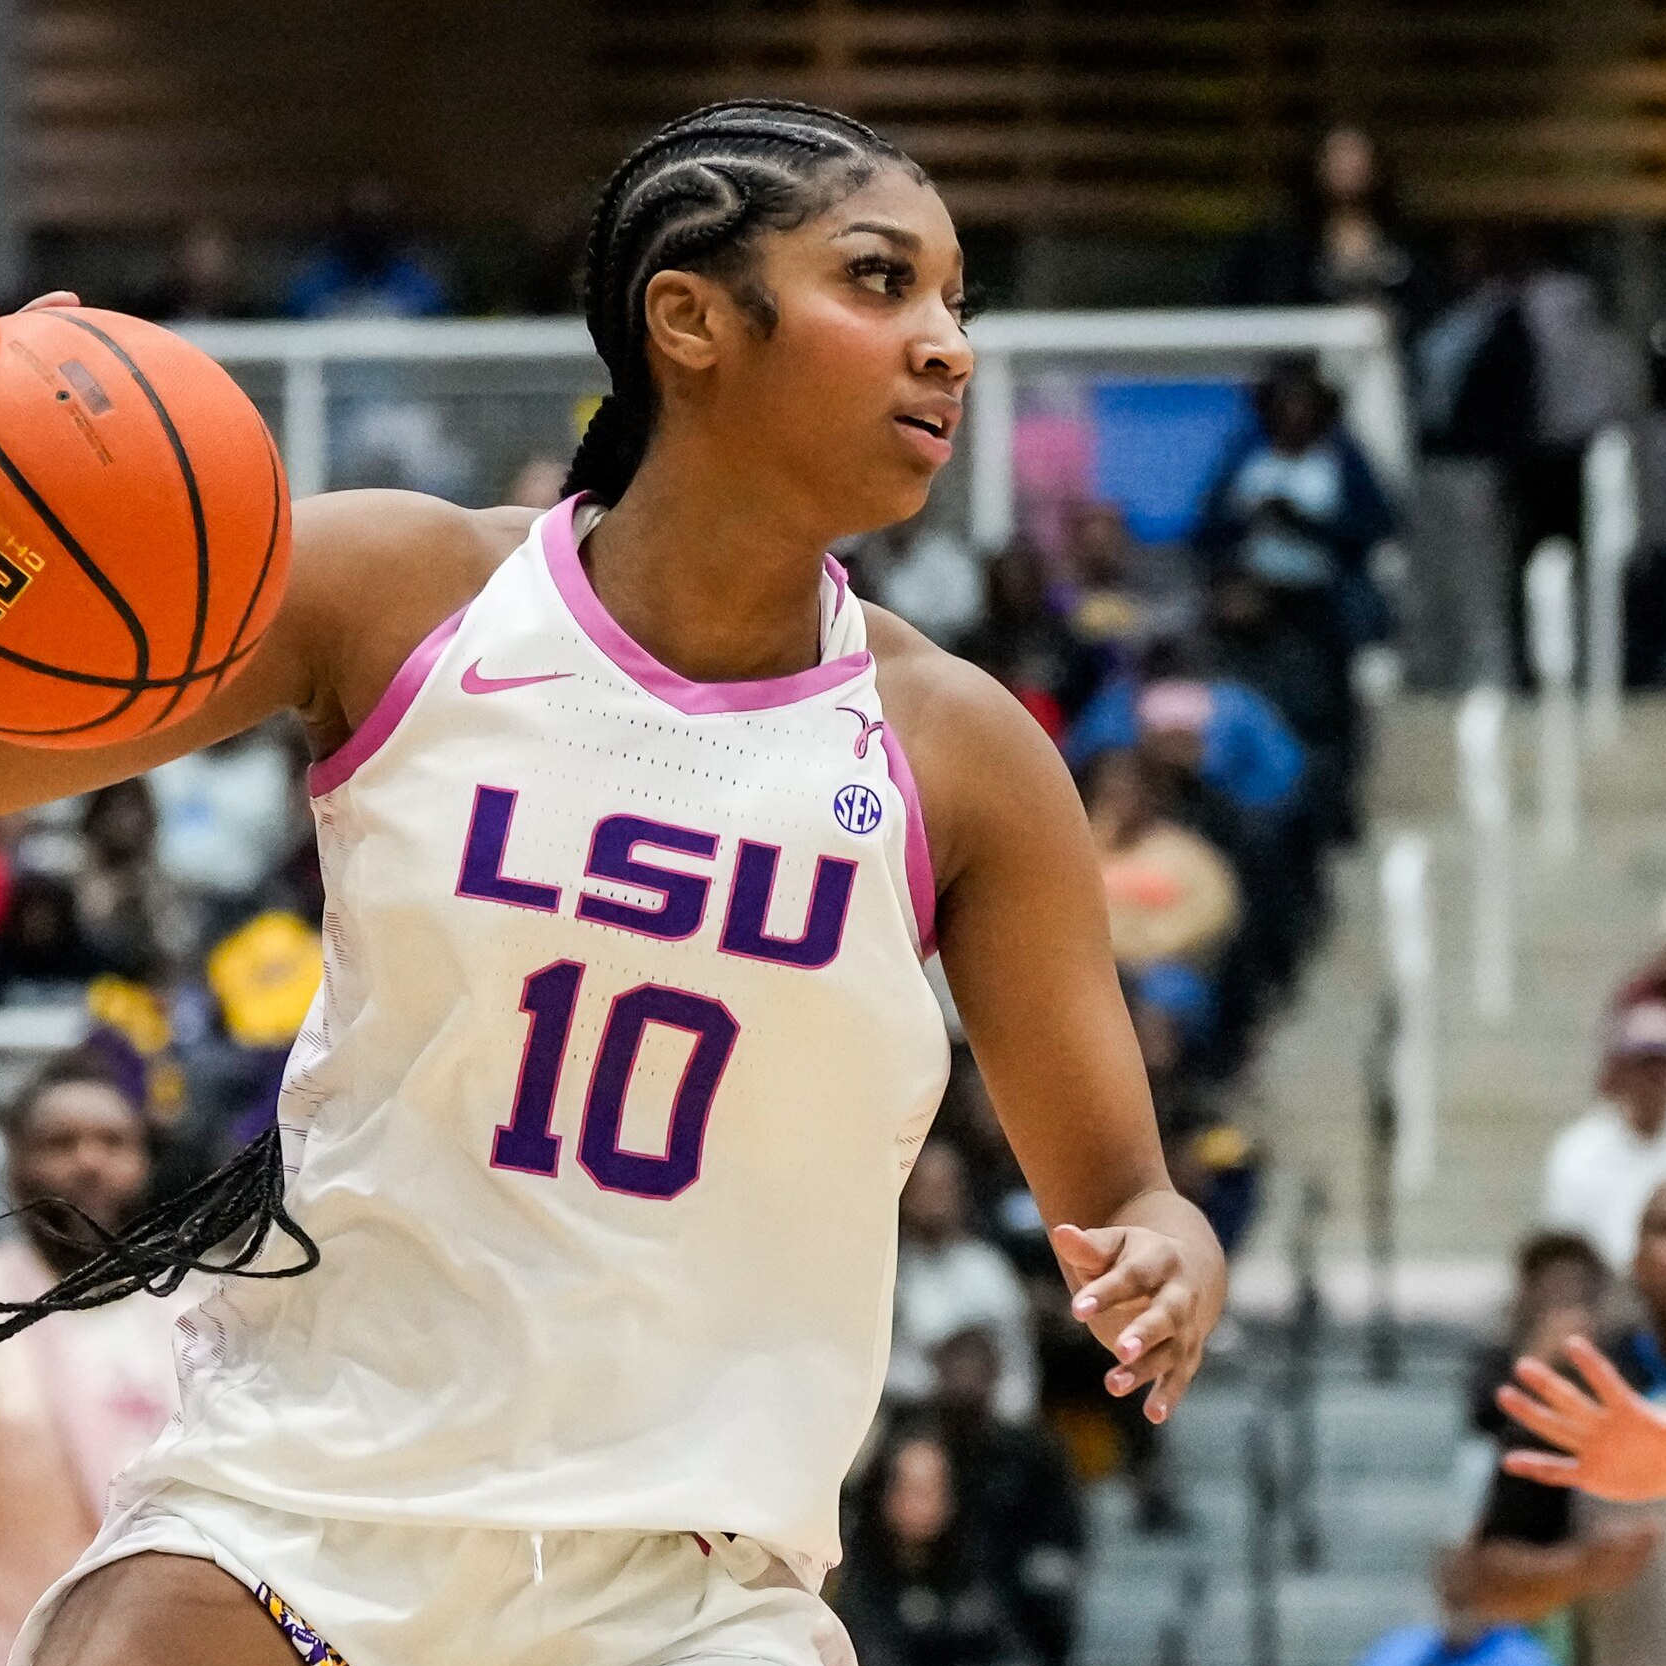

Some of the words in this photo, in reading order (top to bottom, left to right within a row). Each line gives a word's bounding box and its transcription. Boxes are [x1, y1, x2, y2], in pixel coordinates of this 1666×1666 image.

[454, 783, 858, 970] LSU
[835, 786, 880, 833] SEC
[489, 957, 741, 1201] 10
